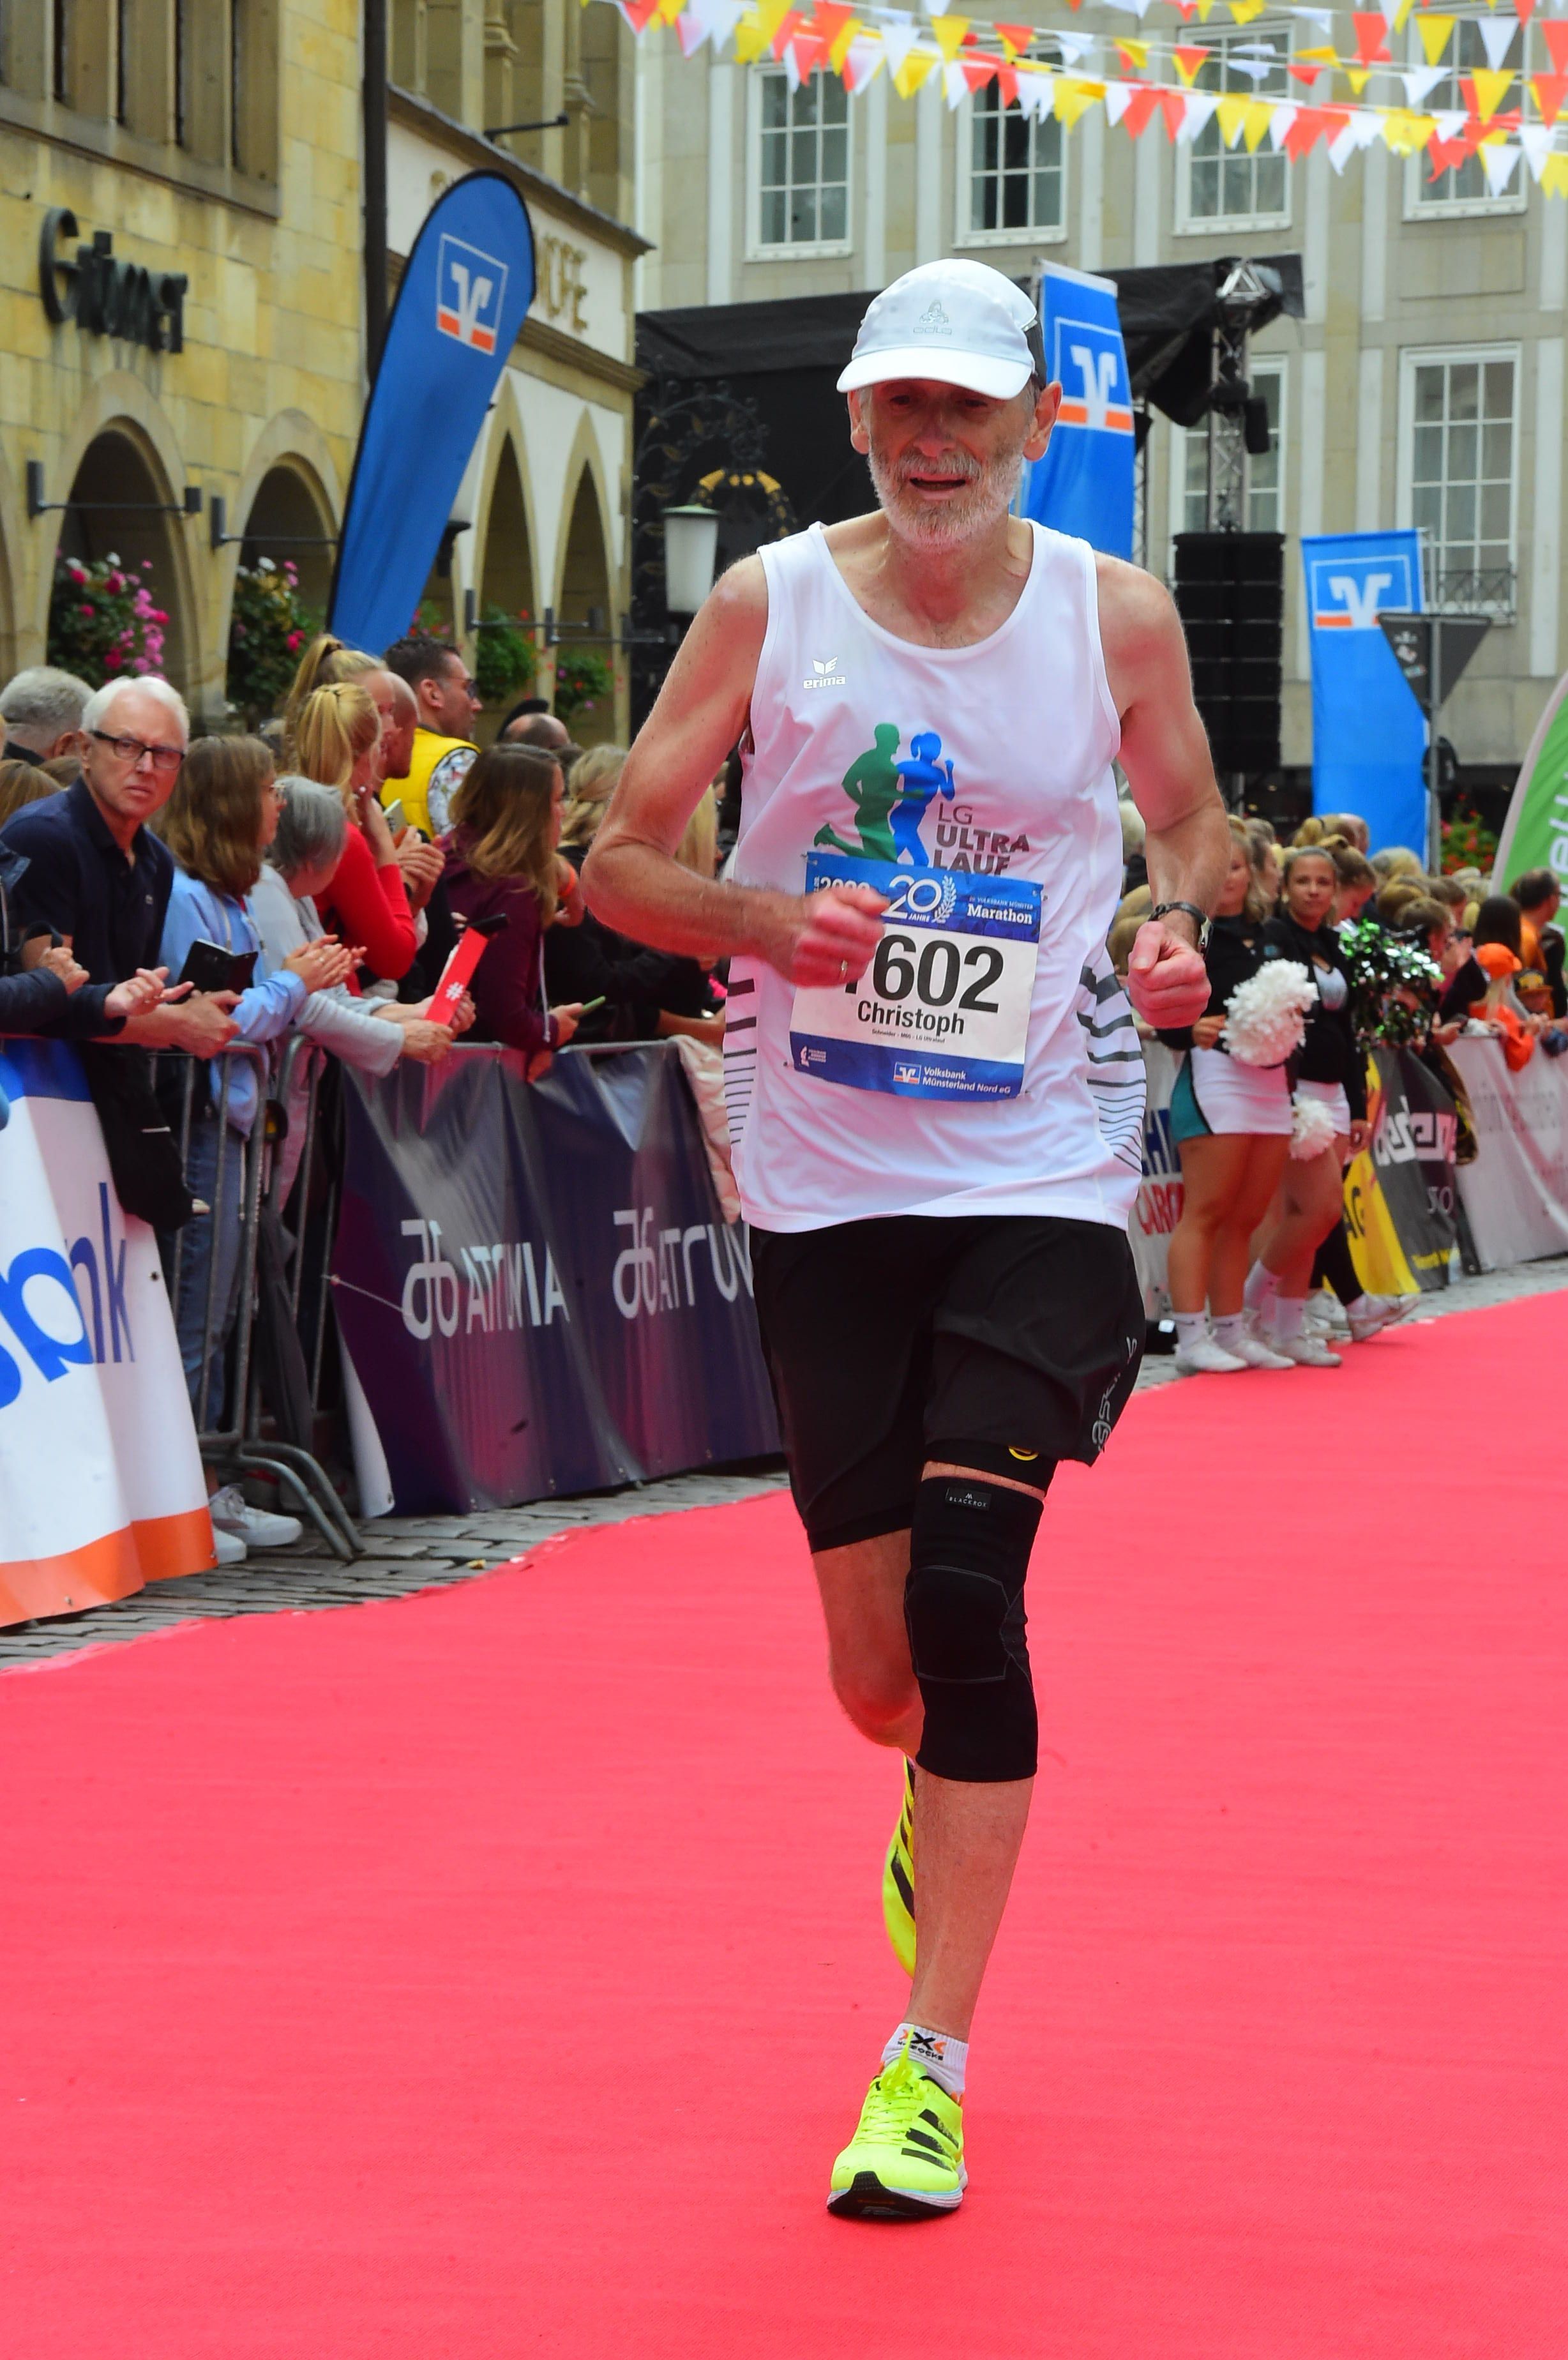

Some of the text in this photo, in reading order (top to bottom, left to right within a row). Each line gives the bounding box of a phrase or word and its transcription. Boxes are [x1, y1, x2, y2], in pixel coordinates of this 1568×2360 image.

[803, 676, 846, 689] erima
[938, 802, 973, 825] LG
[936, 824, 1030, 854] ULTRA
[933, 849, 1011, 876] LAUF
[880, 874, 942, 919] 20
[908, 912, 931, 923] JAHRE
[967, 903, 1033, 925] Marathon
[844, 934, 1004, 1014] 602
[857, 1000, 965, 1035] Christoph
[924, 1066, 966, 1080] Volksbank
[923, 1077, 1011, 1094] Münsterland Nord eG
